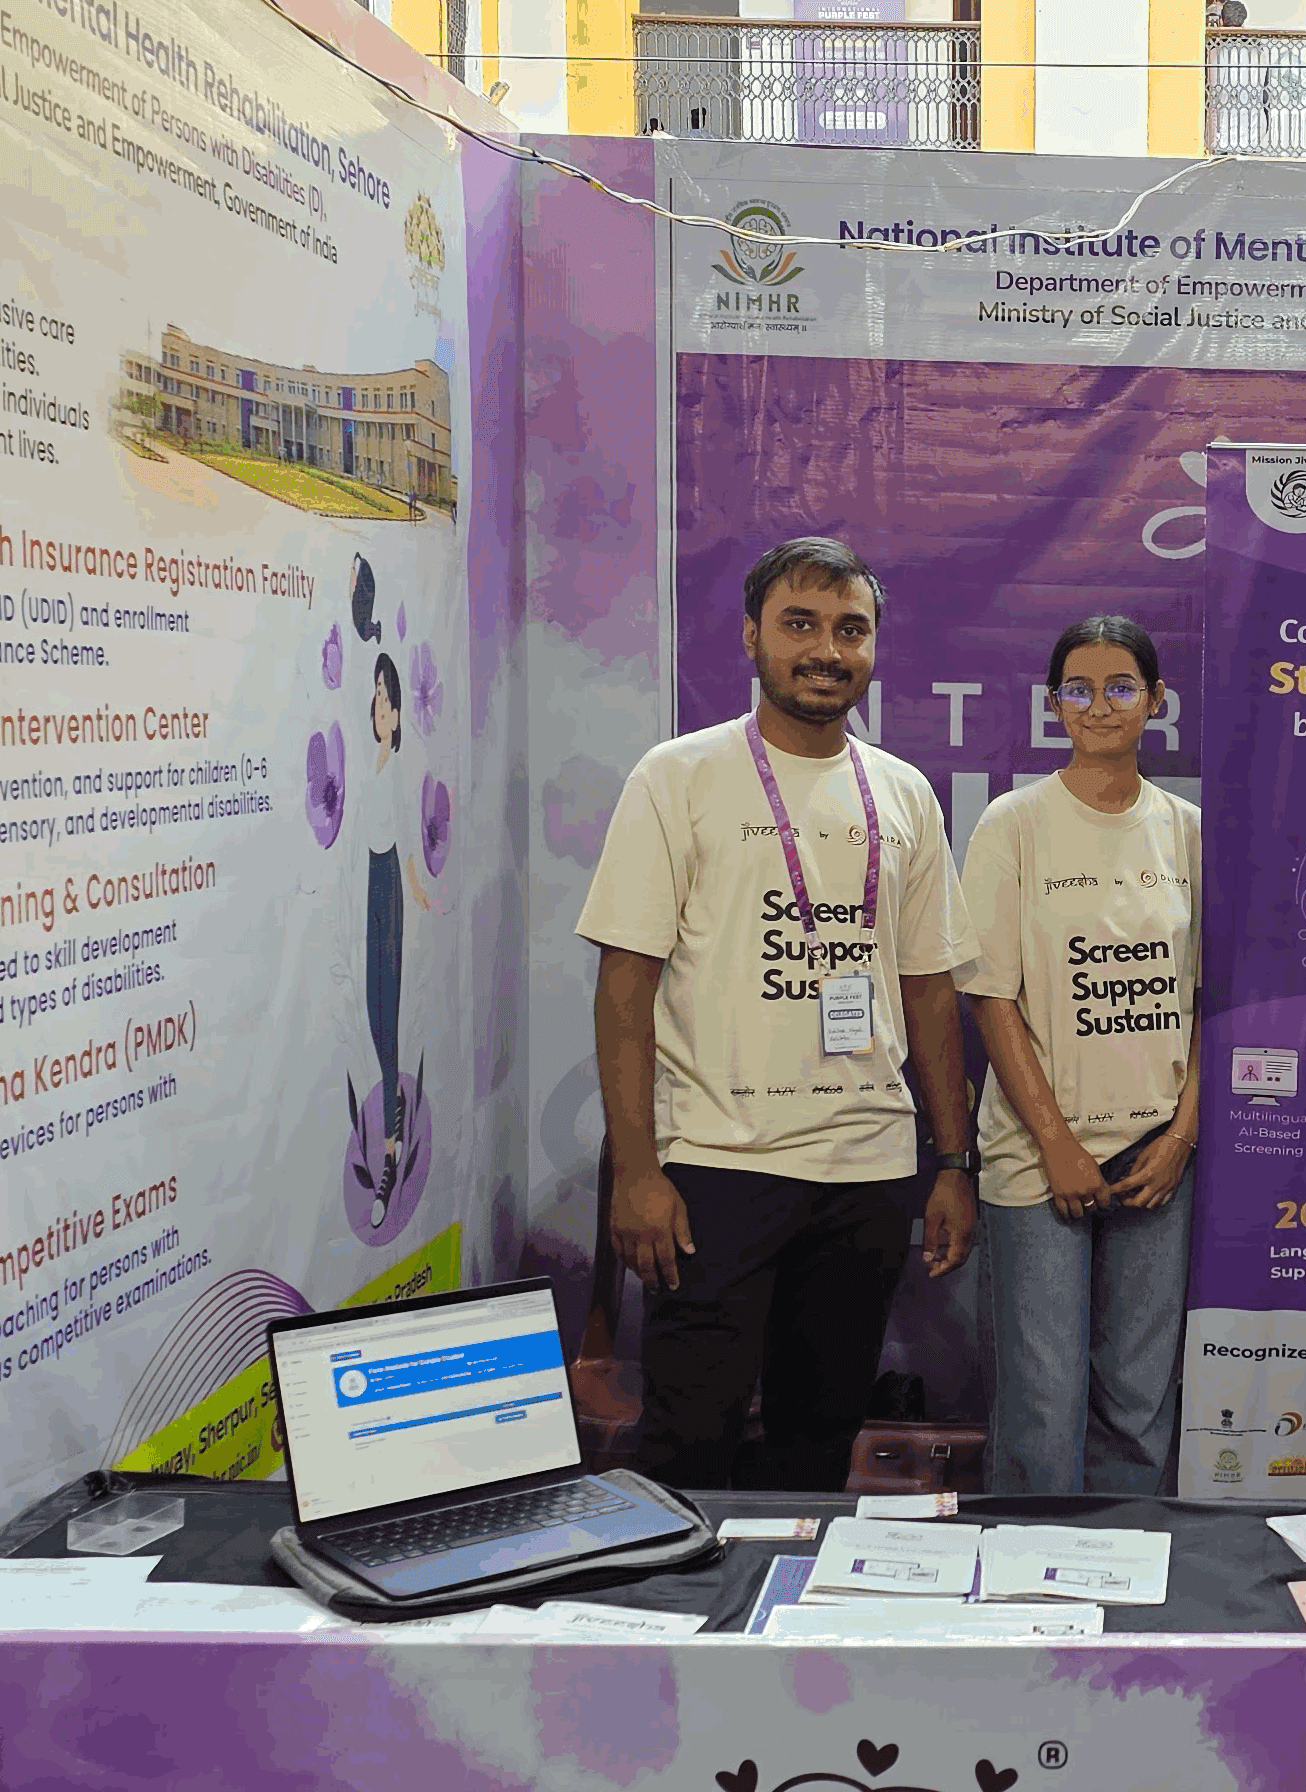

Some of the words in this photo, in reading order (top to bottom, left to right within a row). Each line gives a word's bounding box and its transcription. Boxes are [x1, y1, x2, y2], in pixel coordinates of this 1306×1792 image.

[818, 11, 855, 20] PURPLE
[0, 9, 128, 111] Empowerment
[150, 94, 207, 152] Persons
[242, 146, 306, 207] Disabilities
[124, 10, 198, 95] Health
[203, 60, 336, 184] Rehabilitation,
[339, 146, 391, 210] Sehore
[13, 72, 71, 132] Justice
[223, 181, 297, 241] Government
[839, 219, 998, 255] National
[1008, 225, 1161, 258] Institute
[1169, 228, 1206, 260] of
[717, 291, 800, 314] NIMHR
[995, 269, 1140, 298] Department
[39, 316, 75, 345] care
[979, 300, 1075, 329] Ministry
[1080, 300, 1103, 326] of
[1111, 302, 1182, 328] Social
[1186, 303, 1266, 331] Justice
[2, 381, 90, 431] individuals
[18, 429, 60, 465] lives.
[1251, 455, 1293, 465] Mission
[21, 529, 138, 581] Insurance
[144, 547, 257, 597] Registration
[262, 563, 316, 611] Facility
[21, 587, 74, 633] (UDID)
[114, 605, 190, 633] enrollment
[40, 638, 110, 667] Scheme.
[0, 703, 138, 747] ntervention
[143, 705, 209, 741] Center
[106, 768, 164, 799] support
[188, 753, 238, 786] children
[240, 752, 268, 787] (0-6
[99, 796, 205, 835] developmental
[207, 789, 274, 820] disabilities.
[86, 854, 216, 911] Consultation
[760, 889, 864, 924] Sceen
[44, 935, 77, 971] skill
[80, 918, 178, 963] development
[1067, 935, 1170, 966] Screen
[10, 988, 57, 1029] types
[81, 960, 166, 1003] disabilities.
[1071, 971, 1177, 1007] Suppor
[1075, 1002, 1181, 1037] Sustain
[34, 1038, 118, 1096] Kendra
[124, 999, 197, 1073] (PMDK)
[85, 1087, 145, 1138] persons
[1238, 1126, 1301, 1141] AI-Based
[1234, 1142, 1304, 1159] Screening
[111, 1174, 179, 1232] Exams
[89, 1243, 149, 1301] persons
[17, 1302, 112, 1371] competitive
[115, 1248, 213, 1316] examinations.
